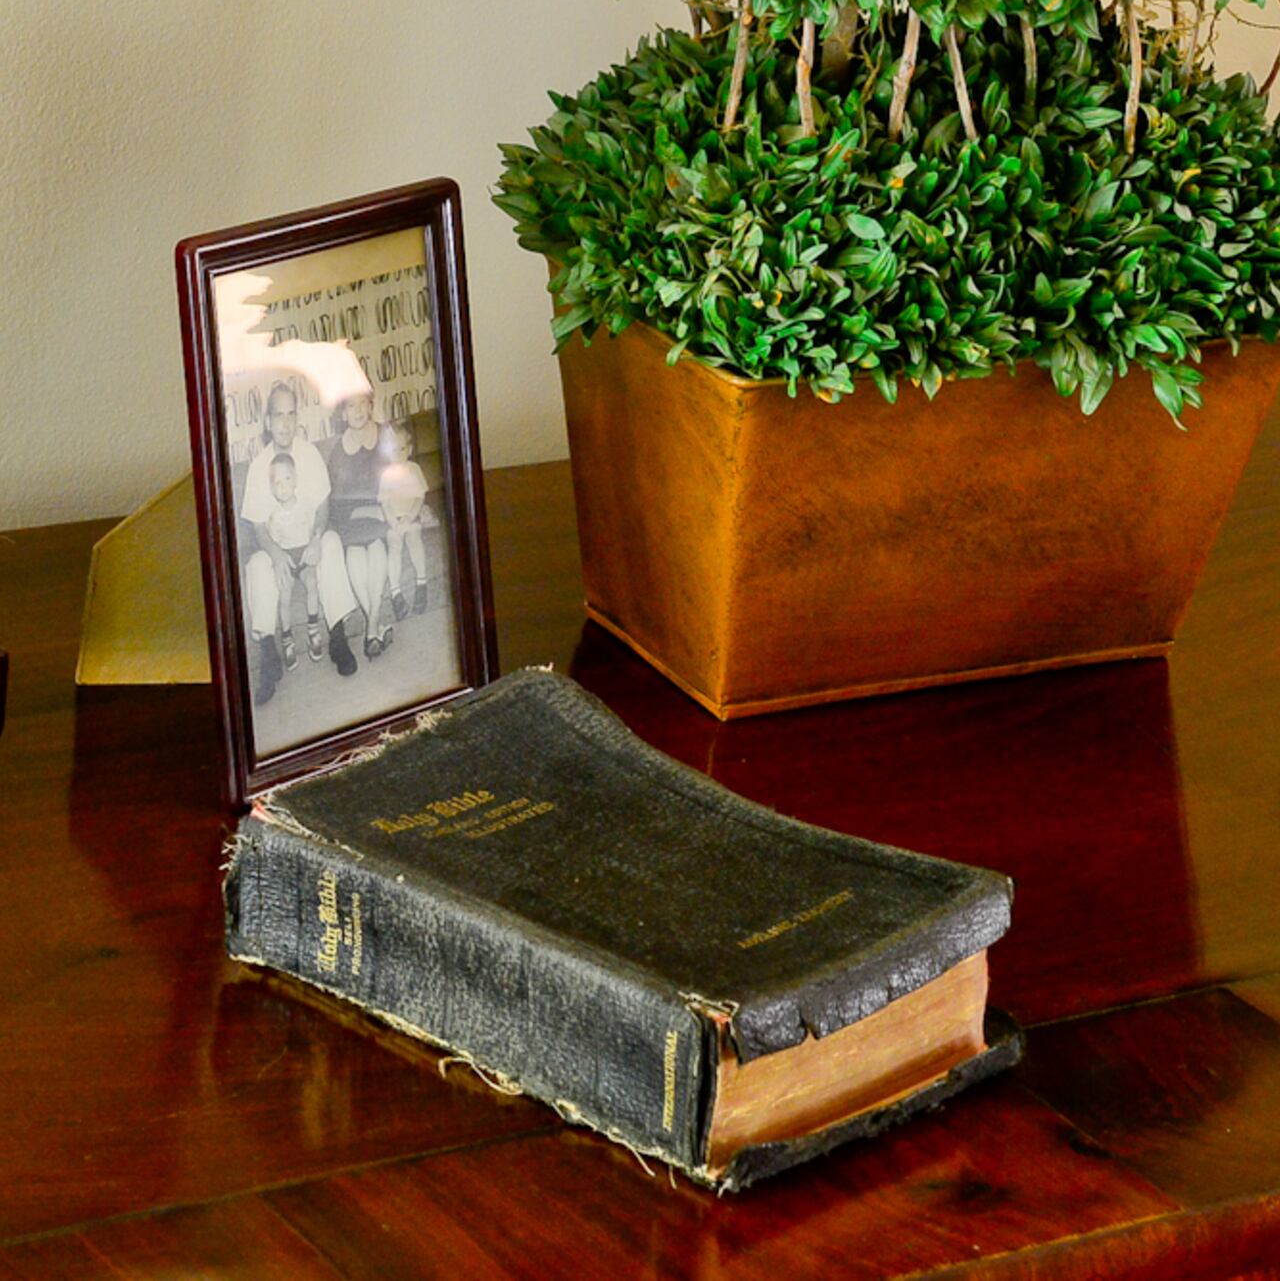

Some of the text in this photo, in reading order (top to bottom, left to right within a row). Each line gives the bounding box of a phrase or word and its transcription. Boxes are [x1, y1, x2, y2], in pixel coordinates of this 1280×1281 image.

[370, 812, 441, 835] Holy
[425, 789, 497, 818] Bible
[316, 868, 343, 974] Holy Bible
[662, 1029, 678, 1134] INTERNATIONAL
